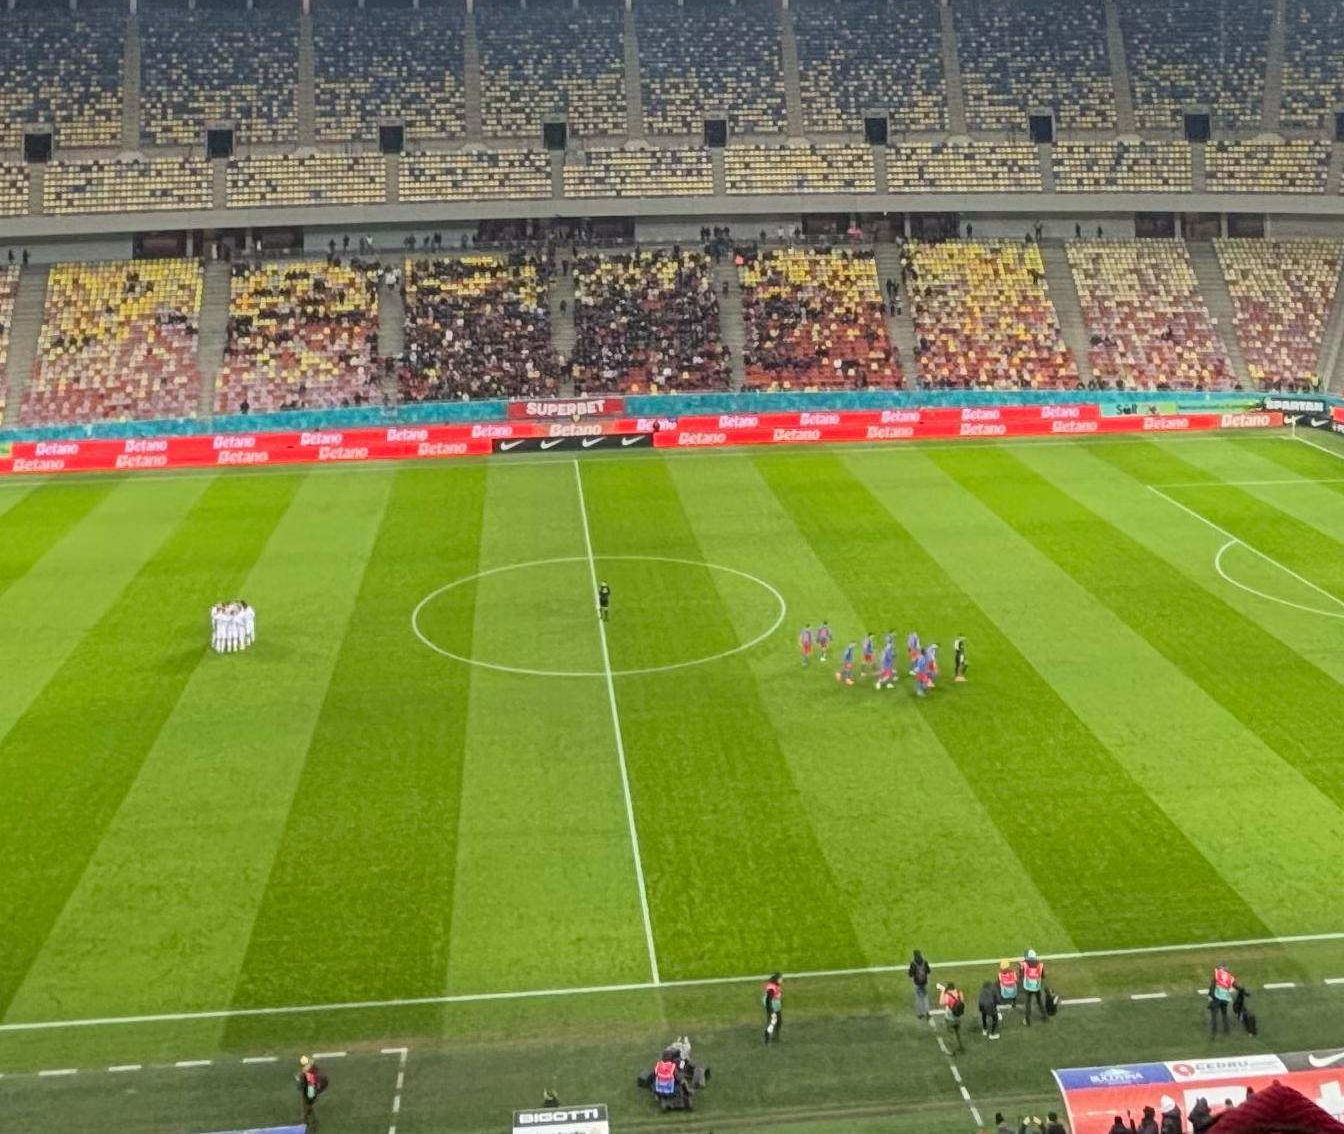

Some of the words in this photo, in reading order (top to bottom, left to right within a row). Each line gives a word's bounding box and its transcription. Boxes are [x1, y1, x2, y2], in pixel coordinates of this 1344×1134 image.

[526, 400, 605, 416] SUPERBET
[1264, 399, 1324, 413] SPARTAN
[1052, 419, 1098, 434] Betano
[1143, 416, 1189, 431] Betano
[1220, 412, 1270, 428] Betano
[550, 422, 603, 438] Betano
[772, 428, 821, 442] Betano
[867, 424, 915, 440] Betano
[960, 421, 1006, 437] Betano
[677, 431, 727, 446] Betano
[318, 445, 368, 461] Betano
[418, 441, 468, 456] Betano
[115, 453, 168, 469] Betano
[218, 449, 268, 465] Betano
[13, 458, 65, 473] Betano
[519, 1108, 599, 1124] BIGOTTI
